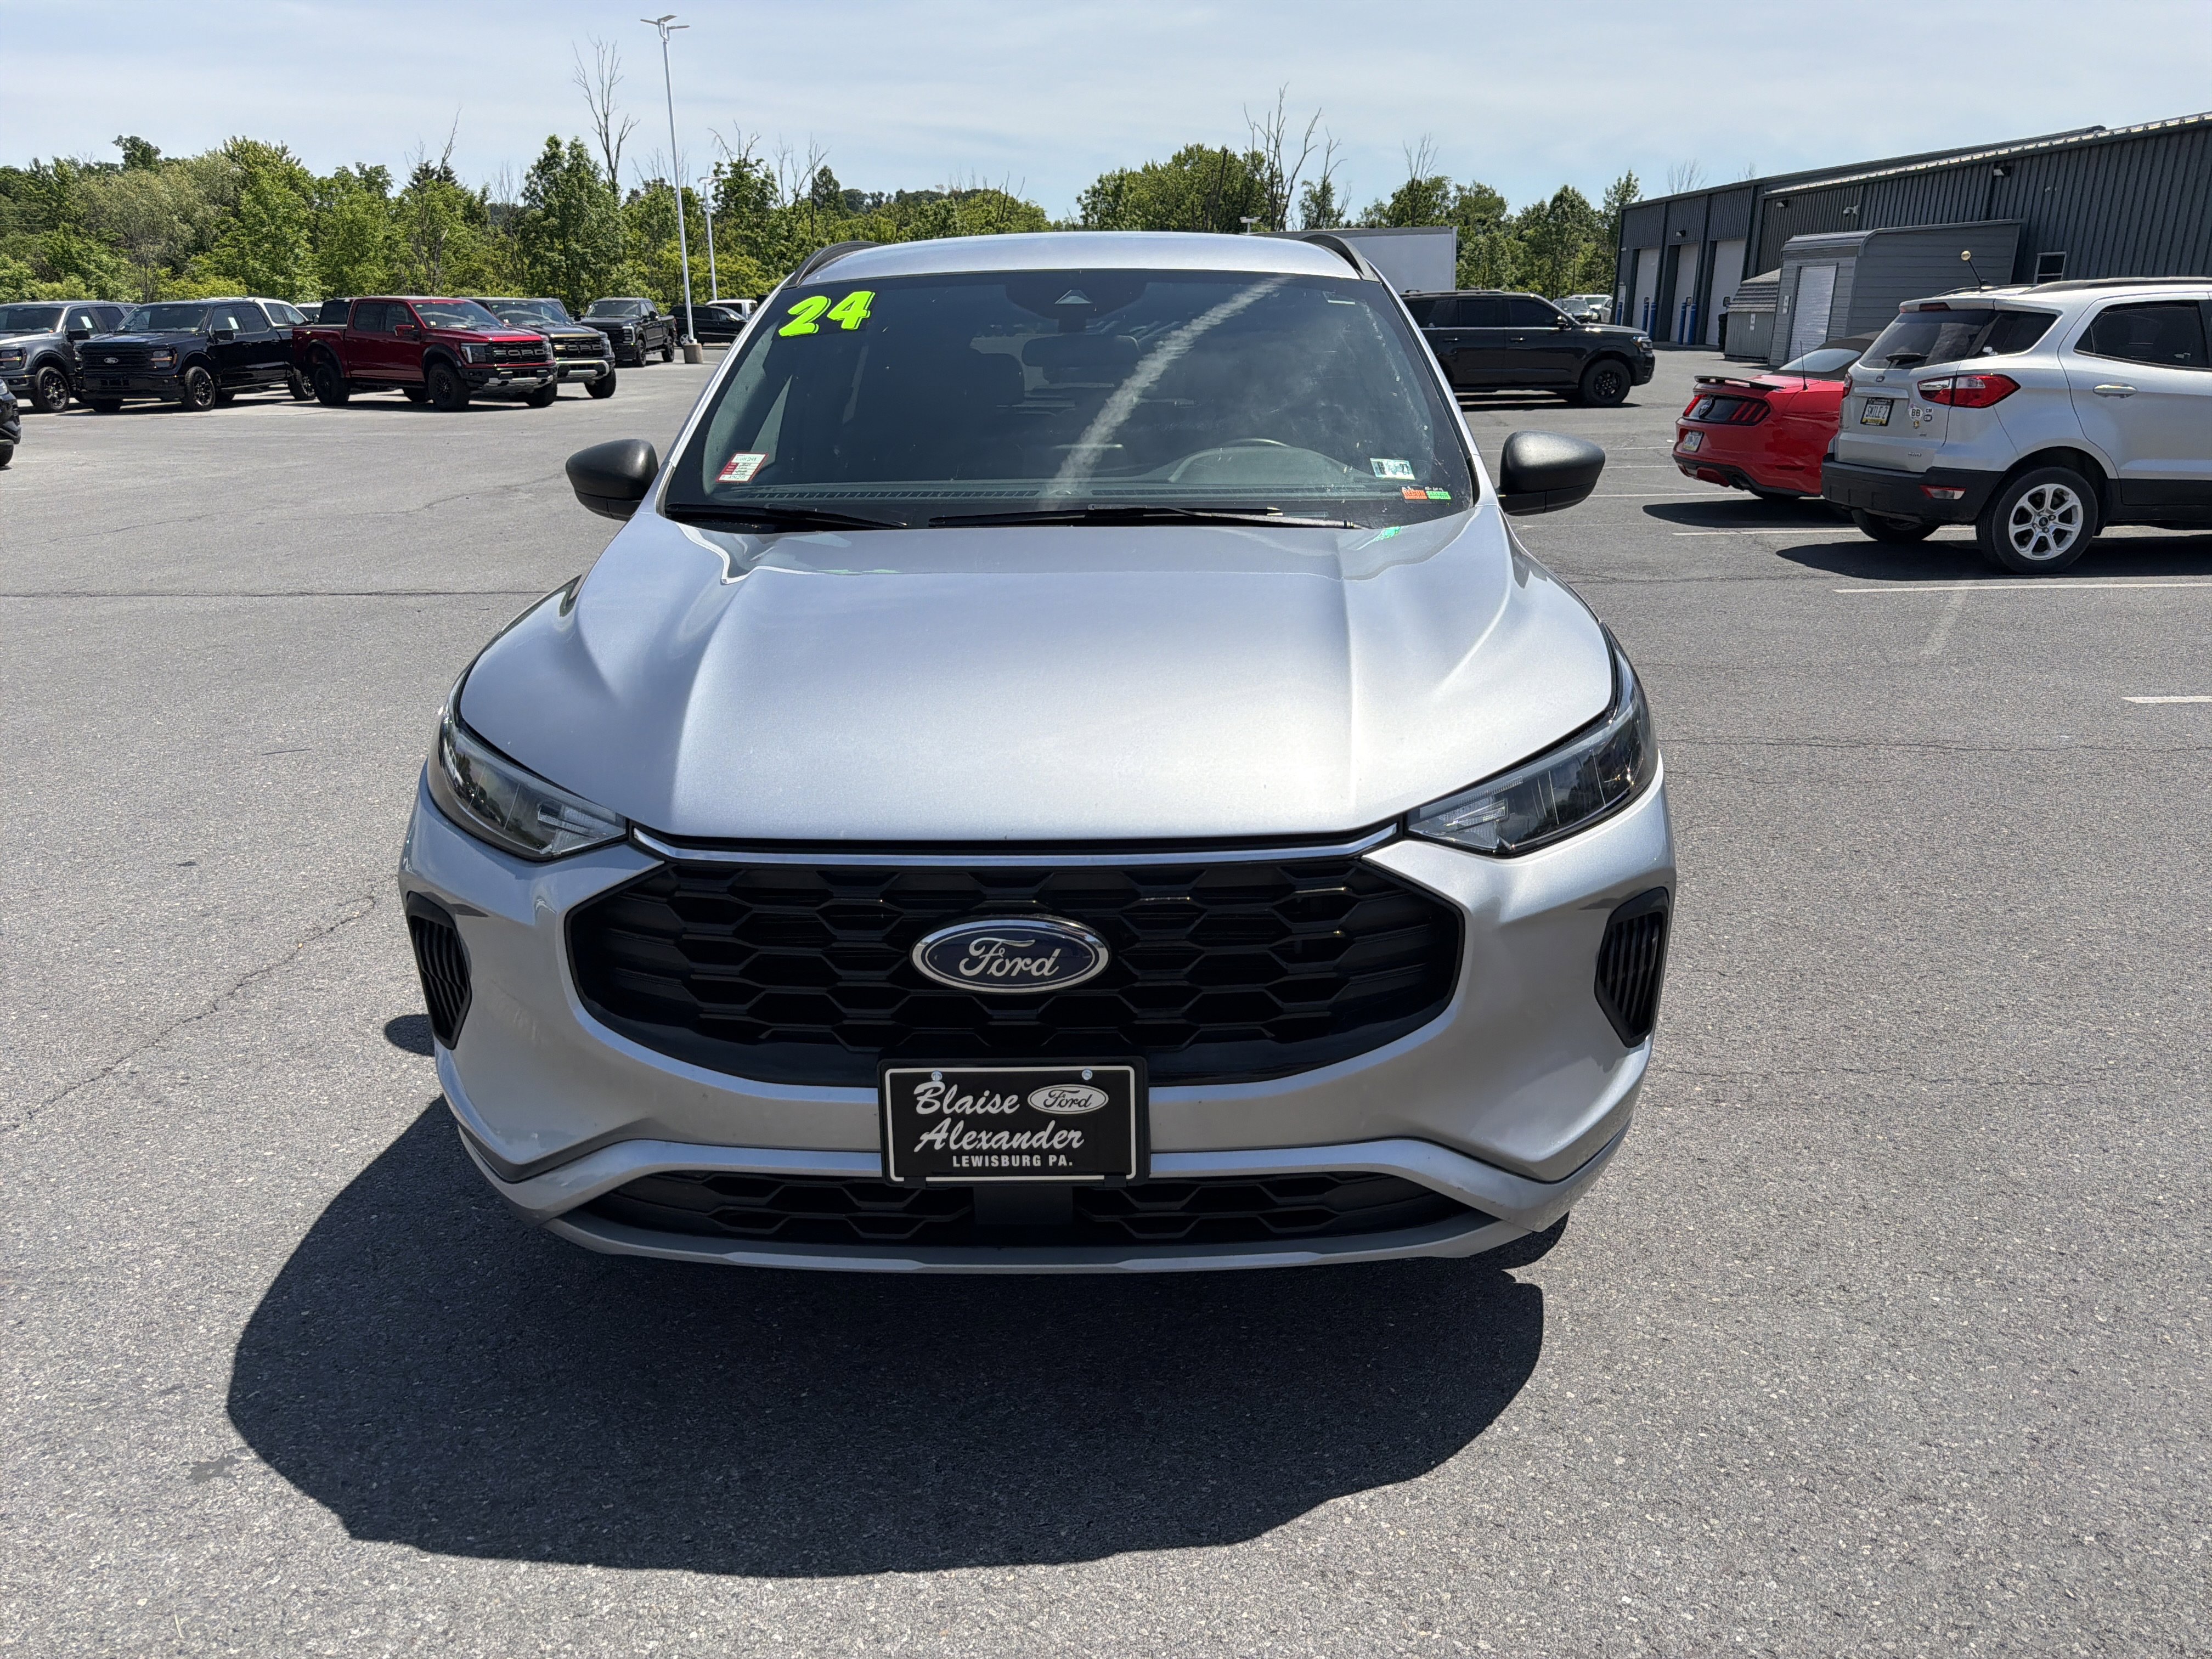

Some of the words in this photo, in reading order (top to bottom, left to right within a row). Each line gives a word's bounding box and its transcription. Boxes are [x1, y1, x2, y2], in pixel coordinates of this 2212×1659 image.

[778, 291, 876, 337] 24
[1866, 405, 1883, 418] SMILE
[1911, 408, 1921, 417] BB
[958, 937, 1062, 977] Ford
[913, 1081, 1020, 1115] Blaise
[1043, 1090, 1094, 1109] Ford
[913, 1117, 1085, 1153] Alexander
[952, 1155, 1042, 1167] LEWISBURG
[1048, 1155, 1073, 1167] PA.
